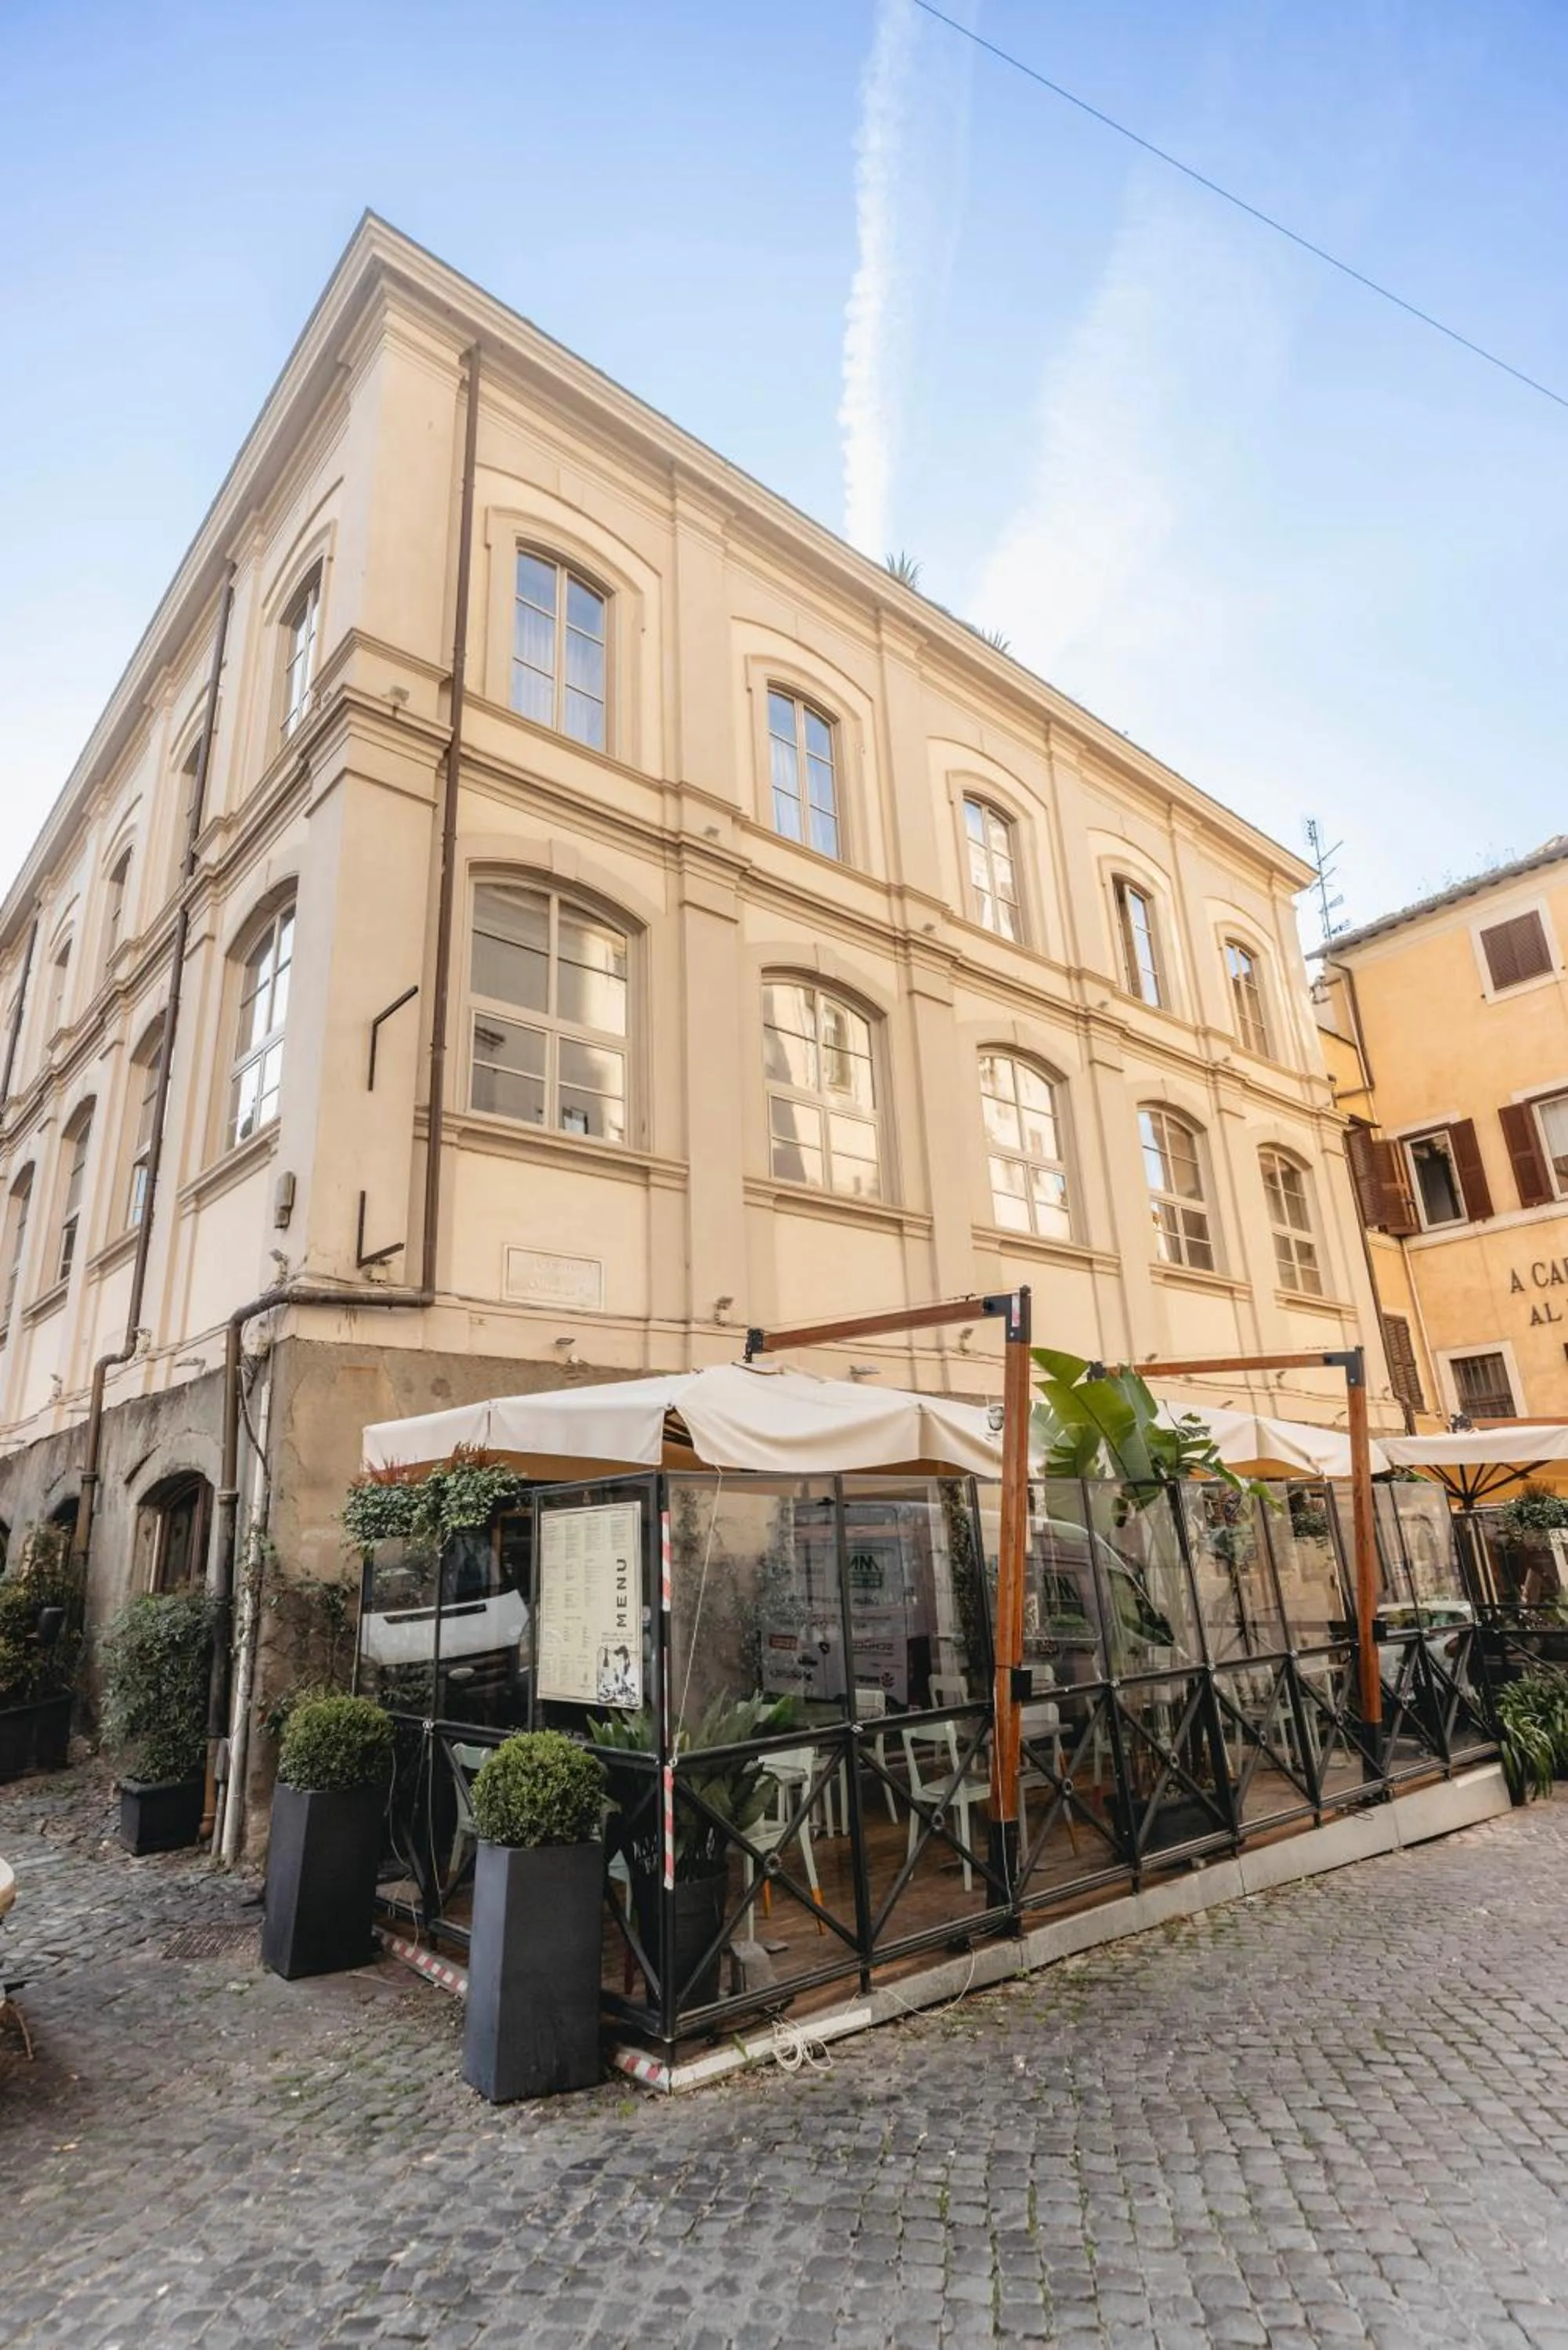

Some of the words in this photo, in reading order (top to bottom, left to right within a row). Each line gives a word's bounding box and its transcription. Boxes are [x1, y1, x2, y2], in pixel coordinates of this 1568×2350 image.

[1510, 1267, 1526, 1293] A
[1530, 1302, 1563, 1326] AL
[616, 1558, 627, 1627] MENU
